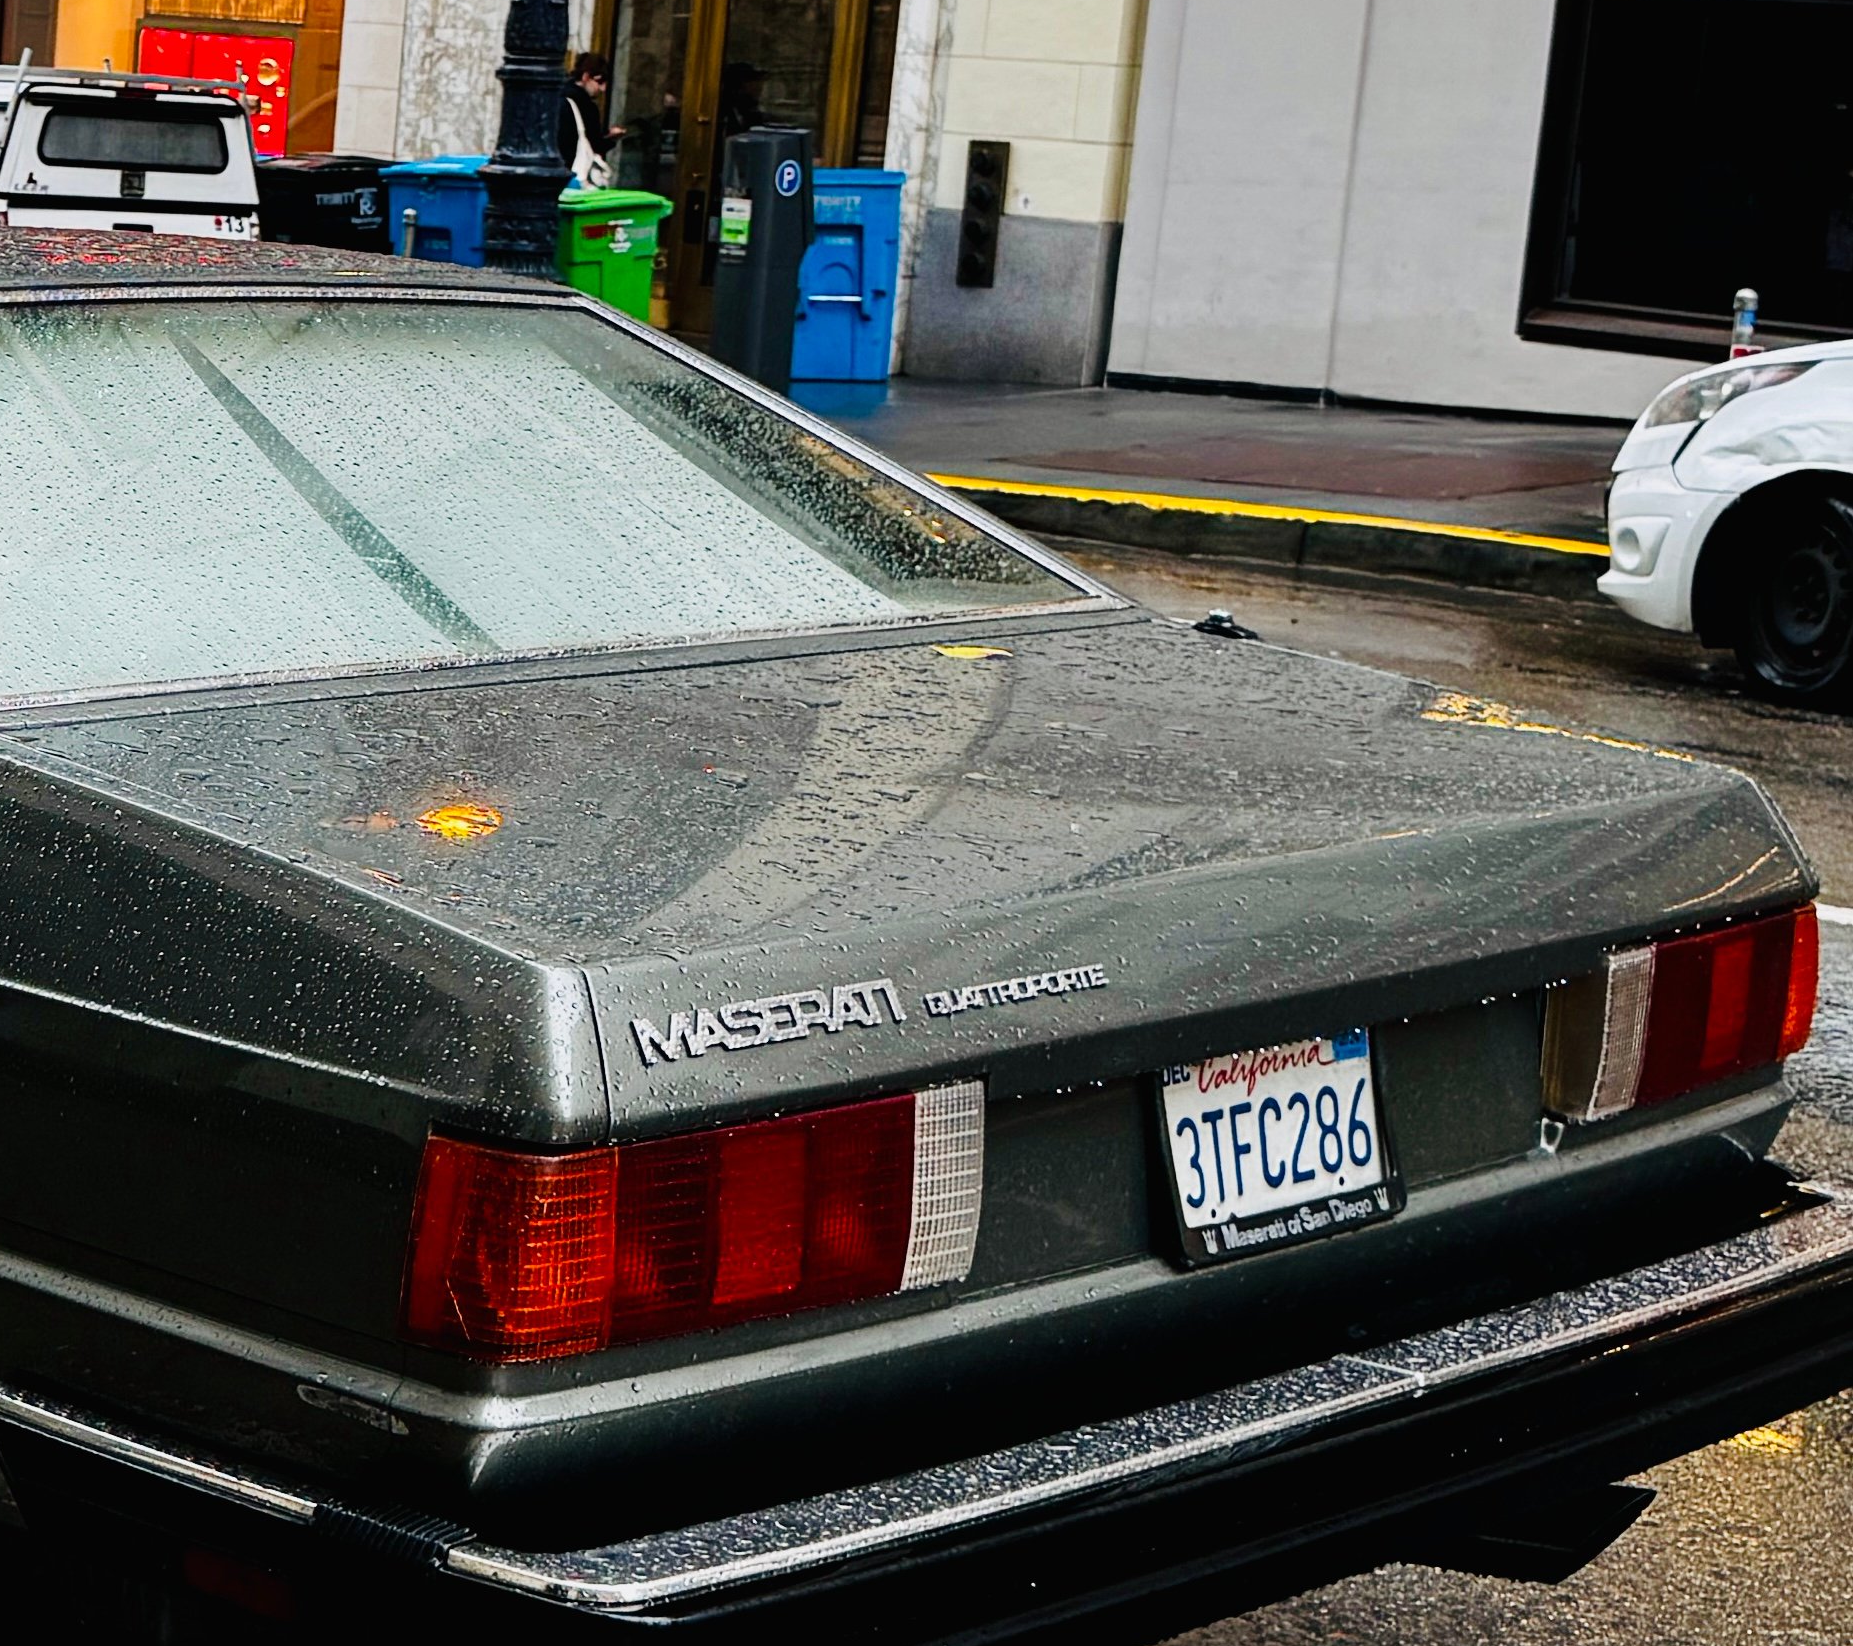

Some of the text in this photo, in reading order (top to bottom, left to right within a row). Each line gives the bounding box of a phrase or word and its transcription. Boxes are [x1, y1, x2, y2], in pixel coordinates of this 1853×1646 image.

[225, 215, 244, 233] 13
[630, 962, 1110, 1066] MASERATI QUATTROPORTE
[1197, 1042, 1336, 1096] California
[1175, 1077, 1372, 1209] 3TFC286
[1221, 1198, 1374, 1250] Maserati of San Diego
